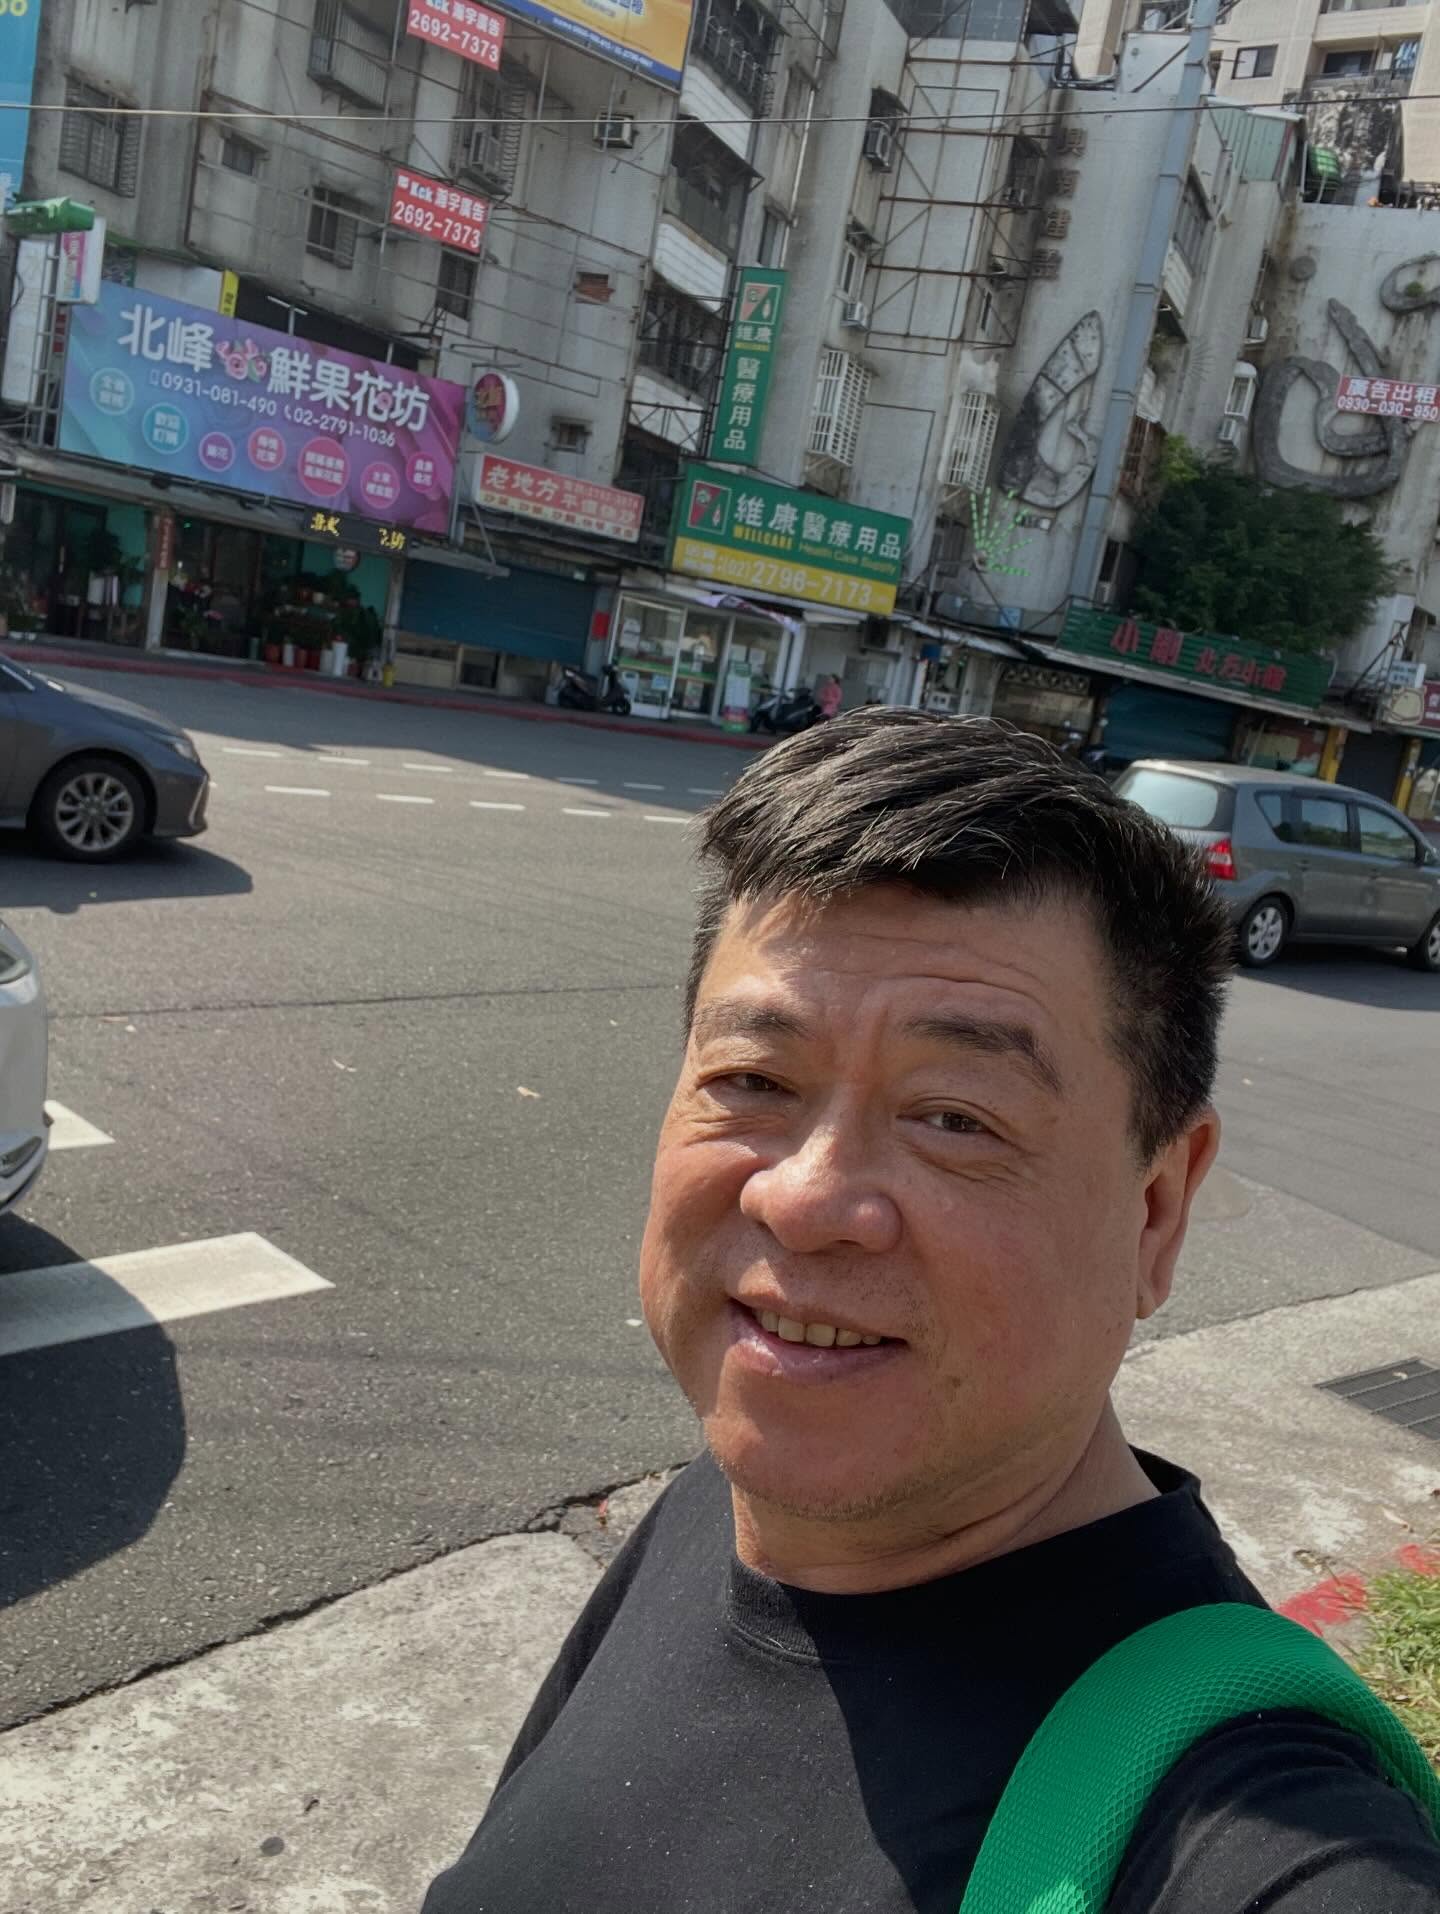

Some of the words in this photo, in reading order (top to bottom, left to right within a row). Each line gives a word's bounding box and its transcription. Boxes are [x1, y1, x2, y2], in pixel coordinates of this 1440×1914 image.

[409, 9, 499, 63] 2692-7373
[394, 201, 481, 249] 2692-7373
[117, 304, 214, 372] 北峰
[267, 346, 431, 433] 鮮果花坊
[1346, 378, 1437, 404] 廣告出租
[161, 371, 277, 417] 0931-081-490
[293, 407, 396, 447] 02-2791-1036
[723, 357, 761, 451] 醫療用品
[1338, 396, 1438, 418] 0930-030-950
[486, 464, 559, 501] 老地方
[733, 493, 901, 560] 維康醫療用品
